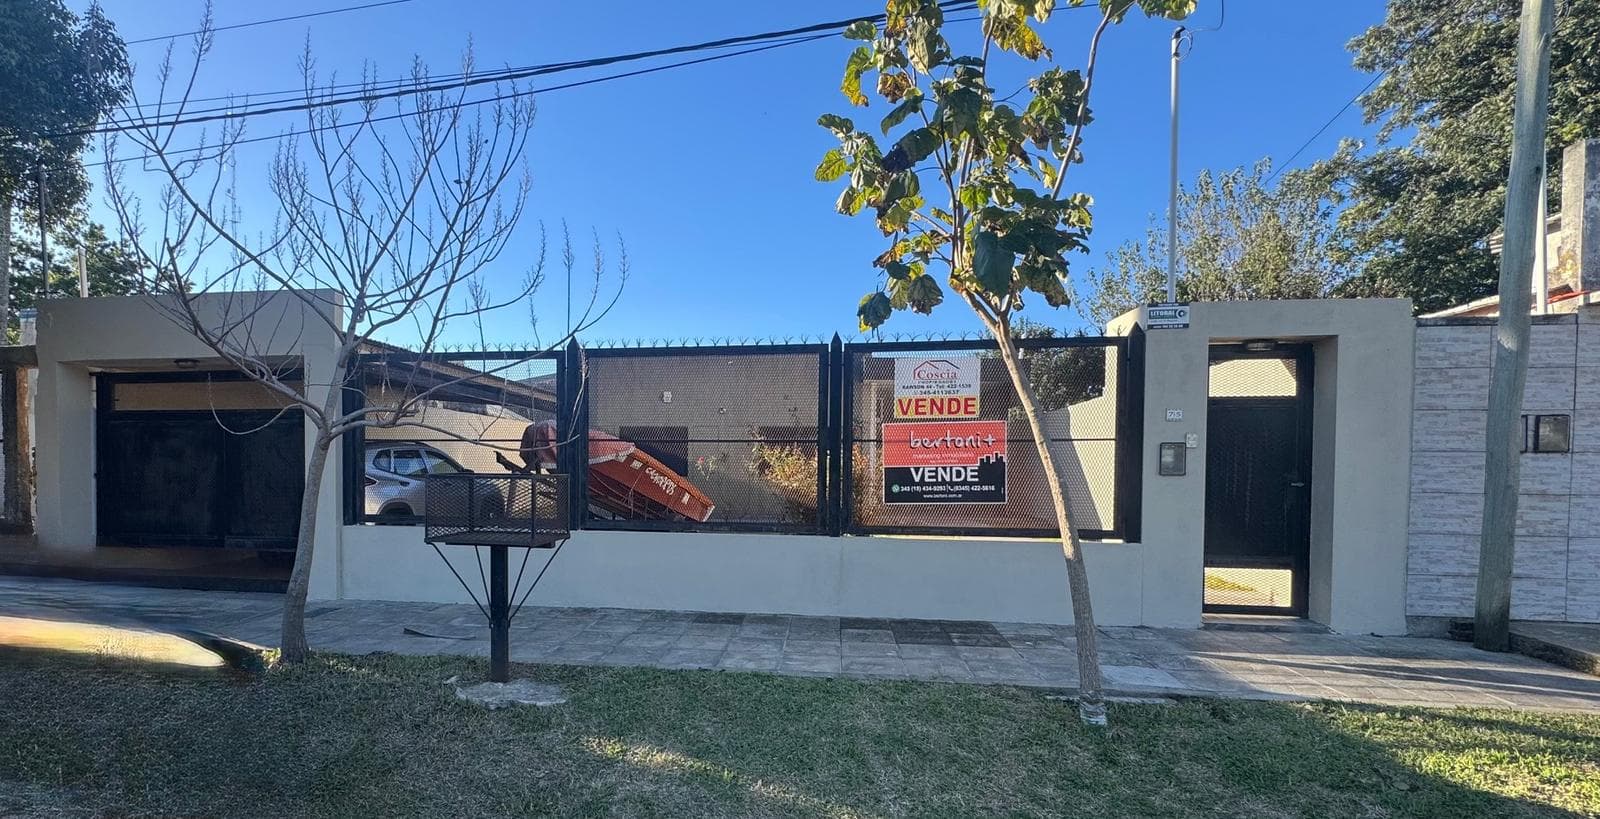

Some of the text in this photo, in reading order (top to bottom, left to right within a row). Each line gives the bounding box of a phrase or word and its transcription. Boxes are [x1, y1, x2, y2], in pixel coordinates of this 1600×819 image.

[916, 369, 958, 380] Coscia
[897, 397, 977, 416] VENDE
[910, 467, 980, 483] VENDE
